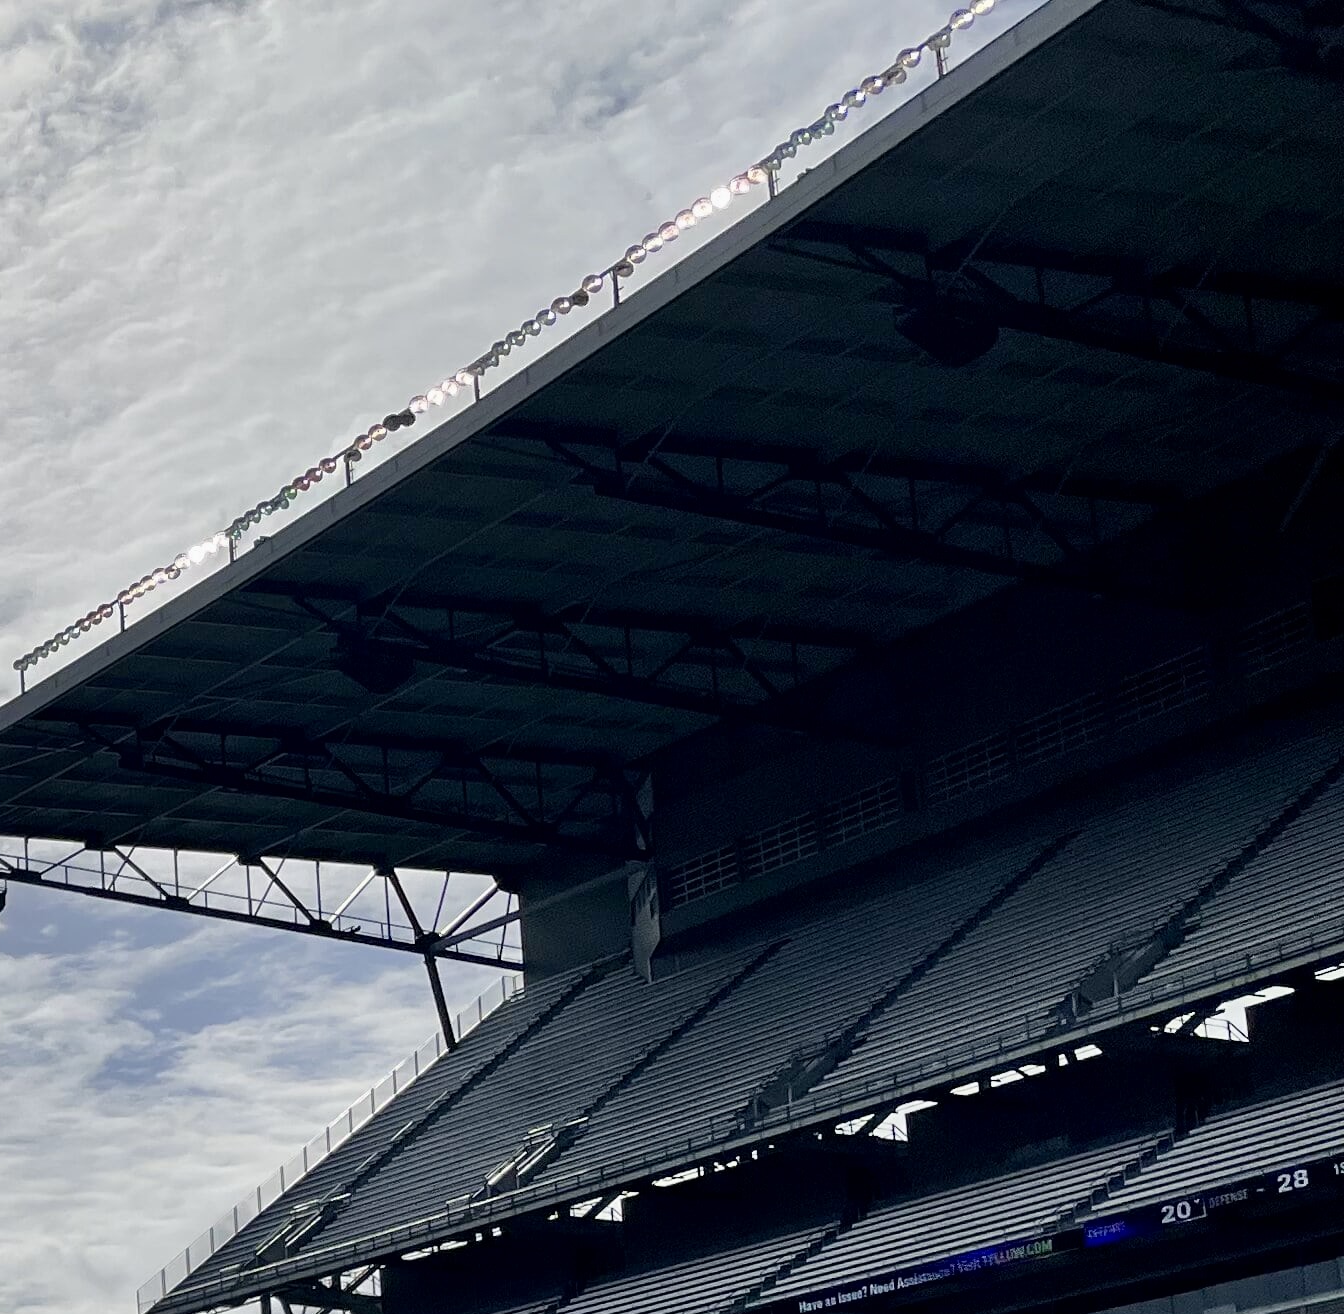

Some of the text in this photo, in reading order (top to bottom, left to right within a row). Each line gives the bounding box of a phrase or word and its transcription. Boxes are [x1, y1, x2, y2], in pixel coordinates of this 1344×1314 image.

[1277, 1169, 1309, 1193] 28
[1162, 1201, 1191, 1223] 20
[870, 1280, 895, 1297] Need
